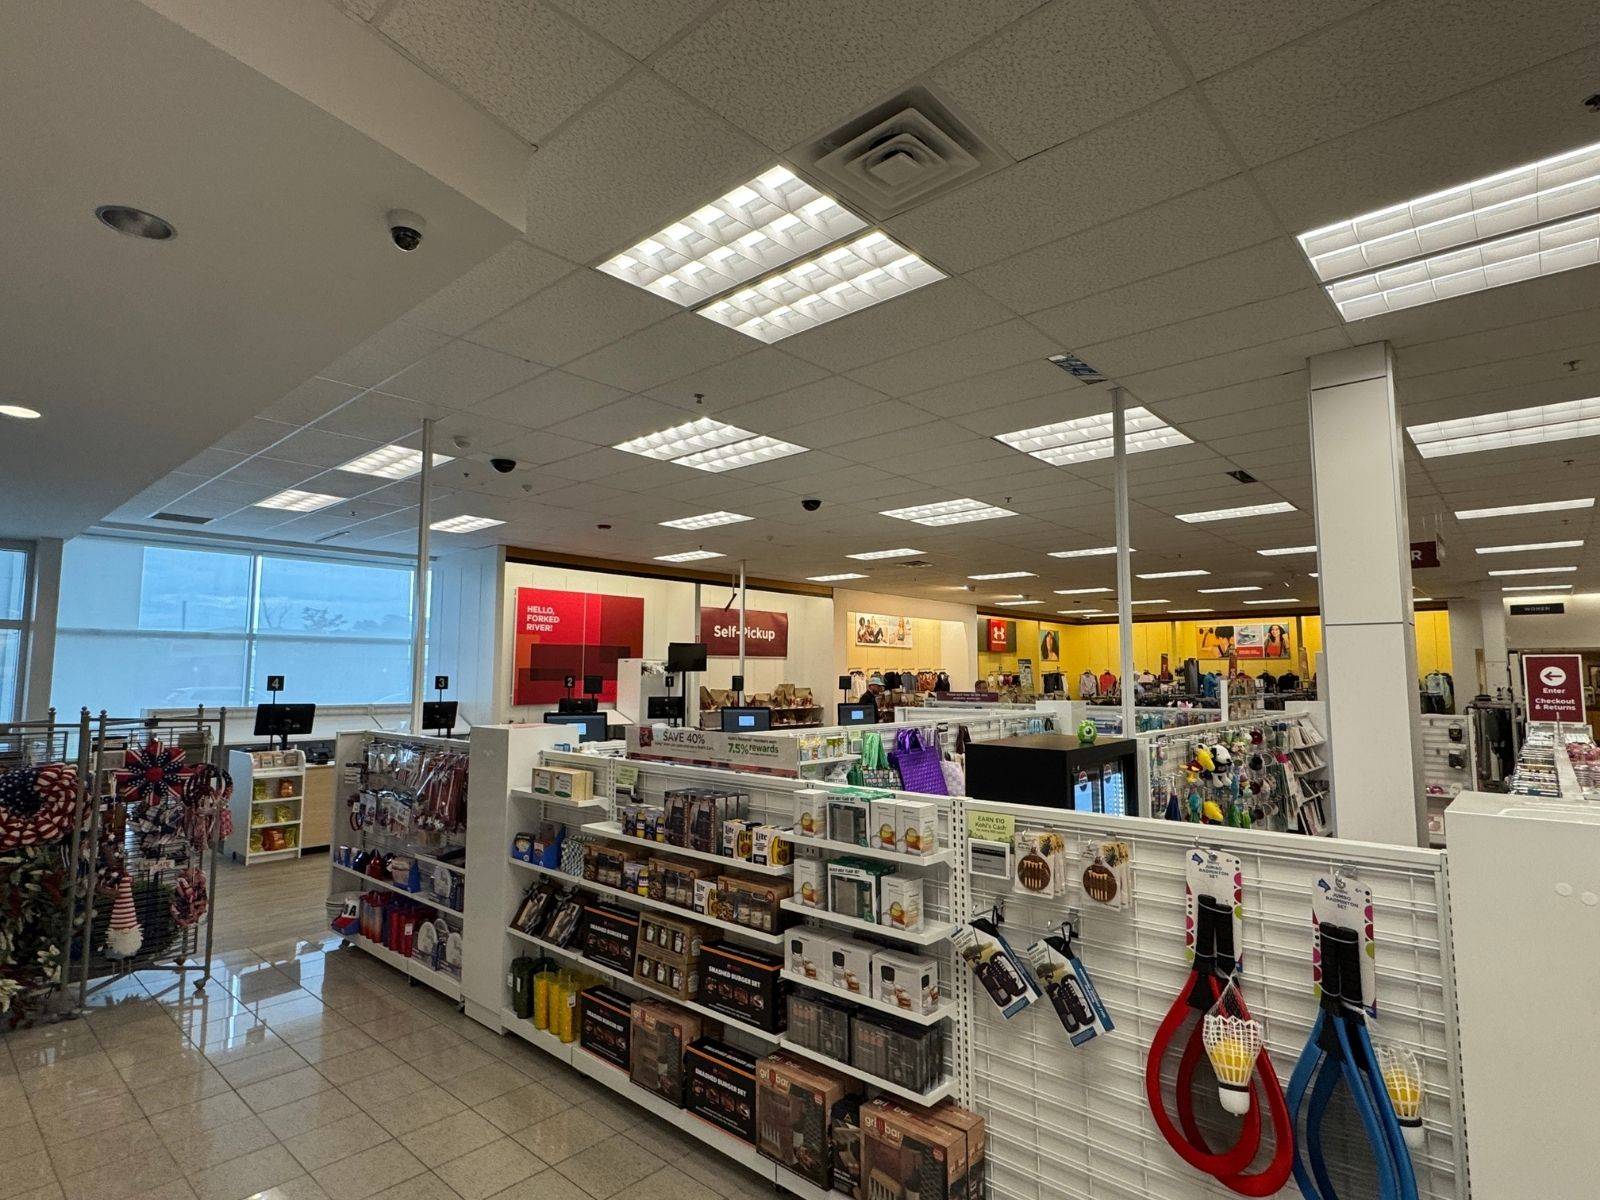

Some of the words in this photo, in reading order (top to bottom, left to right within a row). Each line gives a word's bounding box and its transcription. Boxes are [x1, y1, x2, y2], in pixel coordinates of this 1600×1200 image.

[527, 605, 555, 615] HELLO,
[526, 614, 560, 624] FORKED
[526, 623, 553, 632] RIVER!
[271, 678, 280, 689] 4
[438, 678, 445, 688] 3
[567, 677, 573, 687] 2
[663, 730, 684, 743] SAVE
[687, 733, 706, 745] 40%
[728, 742, 749, 755] 7.5%
[749, 744, 779, 754] rewards
[755, 831, 768, 841] Lite
[1326, 896, 1359, 908] BADMINTON
[708, 965, 731, 978] SMASHED
[731, 973, 751, 985] BURGER
[751, 980, 761, 988] SET
[695, 1067, 718, 1083] SMASHED
[717, 1078, 738, 1093] BURGER
[737, 1087, 747, 1097] SET
